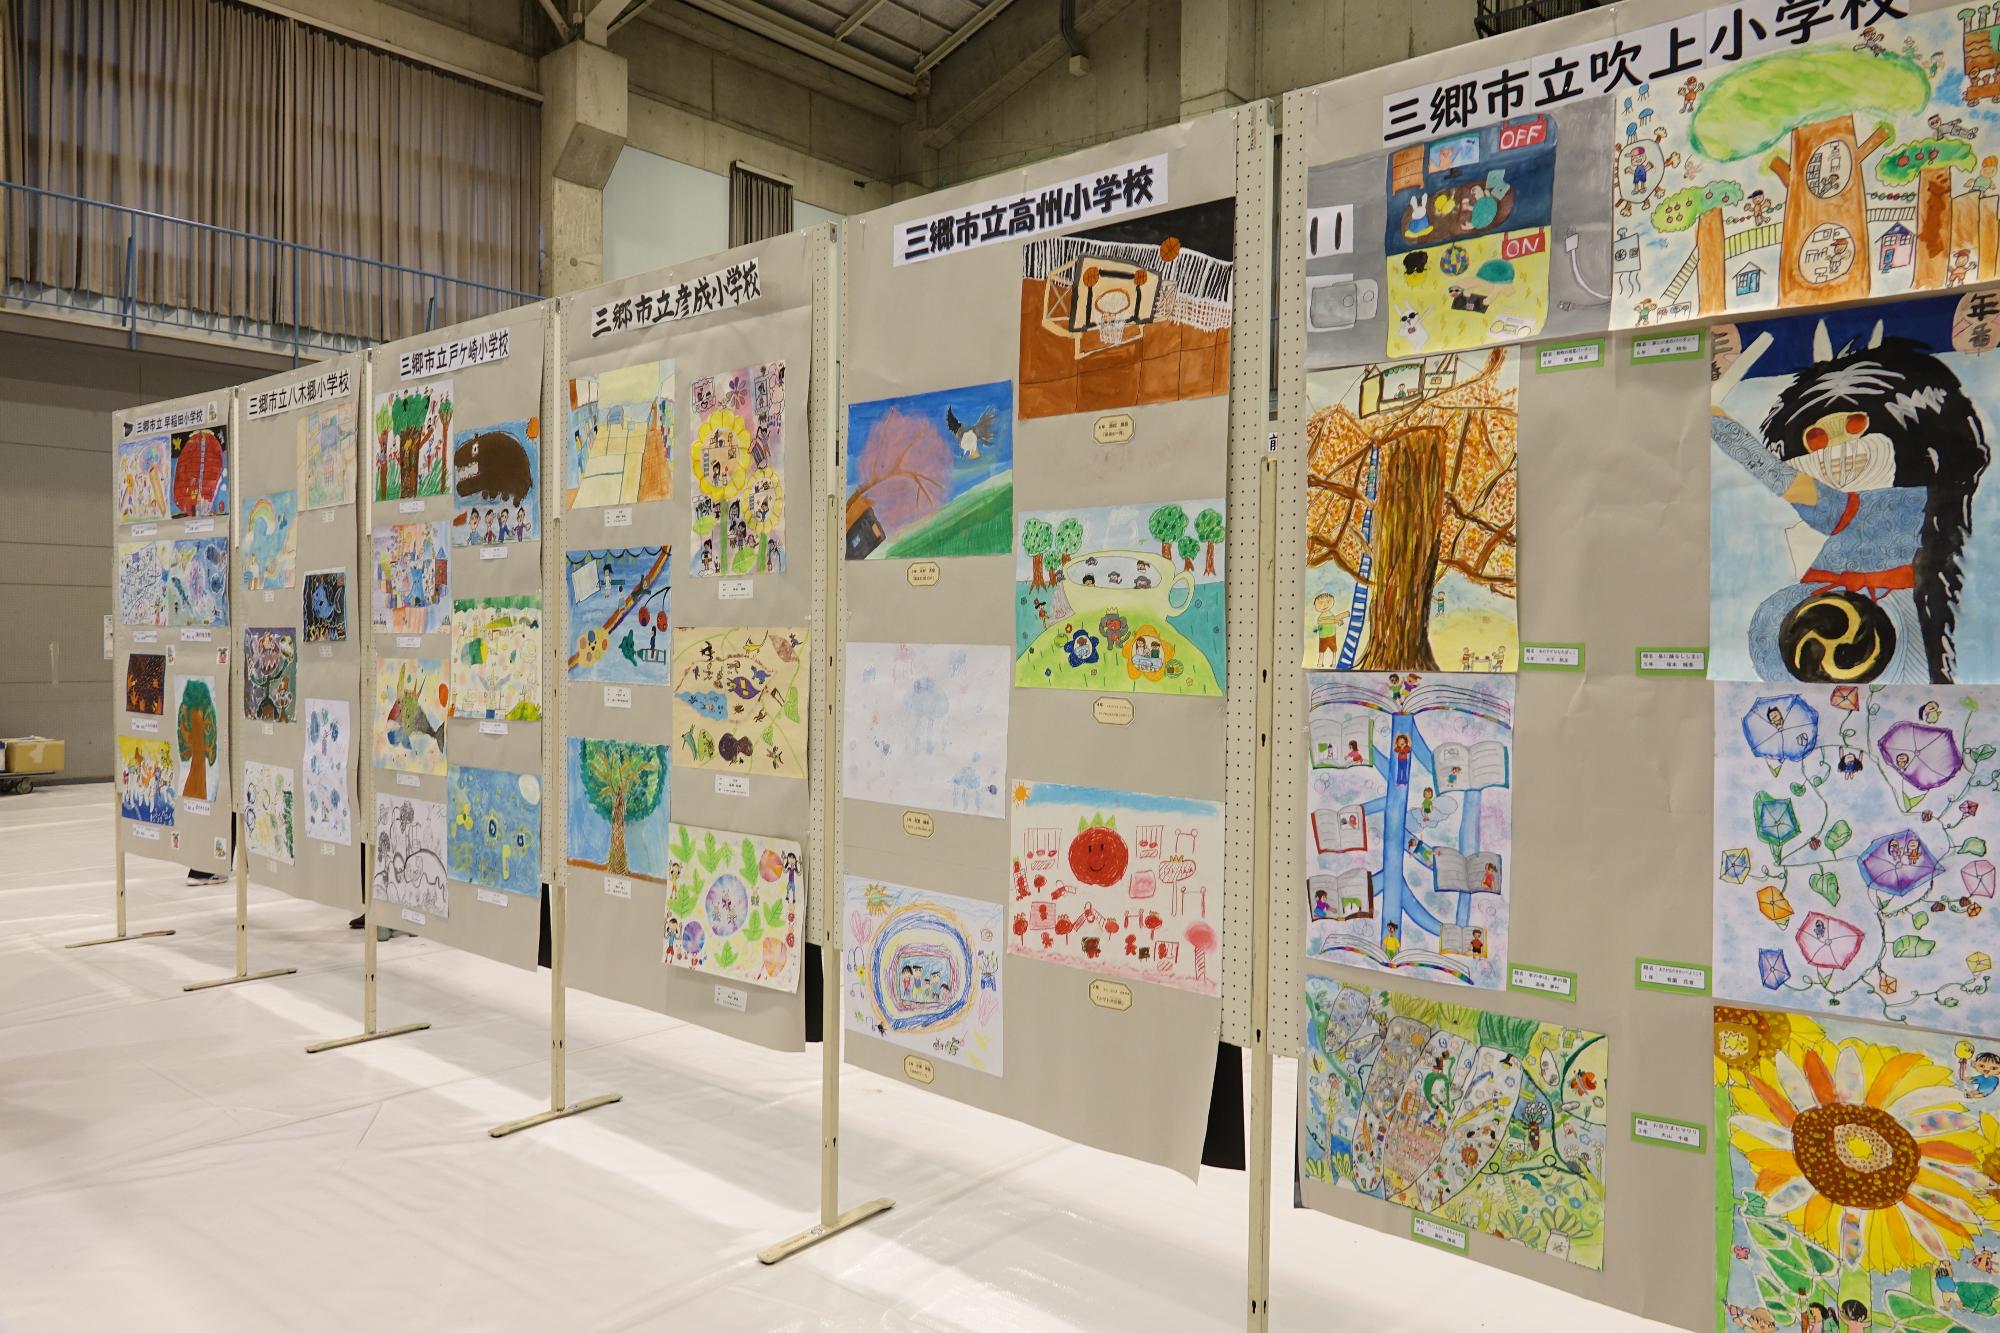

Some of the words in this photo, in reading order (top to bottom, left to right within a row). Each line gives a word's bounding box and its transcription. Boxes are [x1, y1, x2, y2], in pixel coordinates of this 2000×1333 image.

[1383, 0, 1908, 142] 三郷市立吹上小学校
[1499, 124, 1543, 151] OFF
[904, 165, 1154, 260] 三郷市立高州小学校
[1506, 236, 1539, 258] ON
[591, 260, 761, 338] 三郷市立彦成小学校
[249, 369, 350, 415] 三郷市立八木郷小学校
